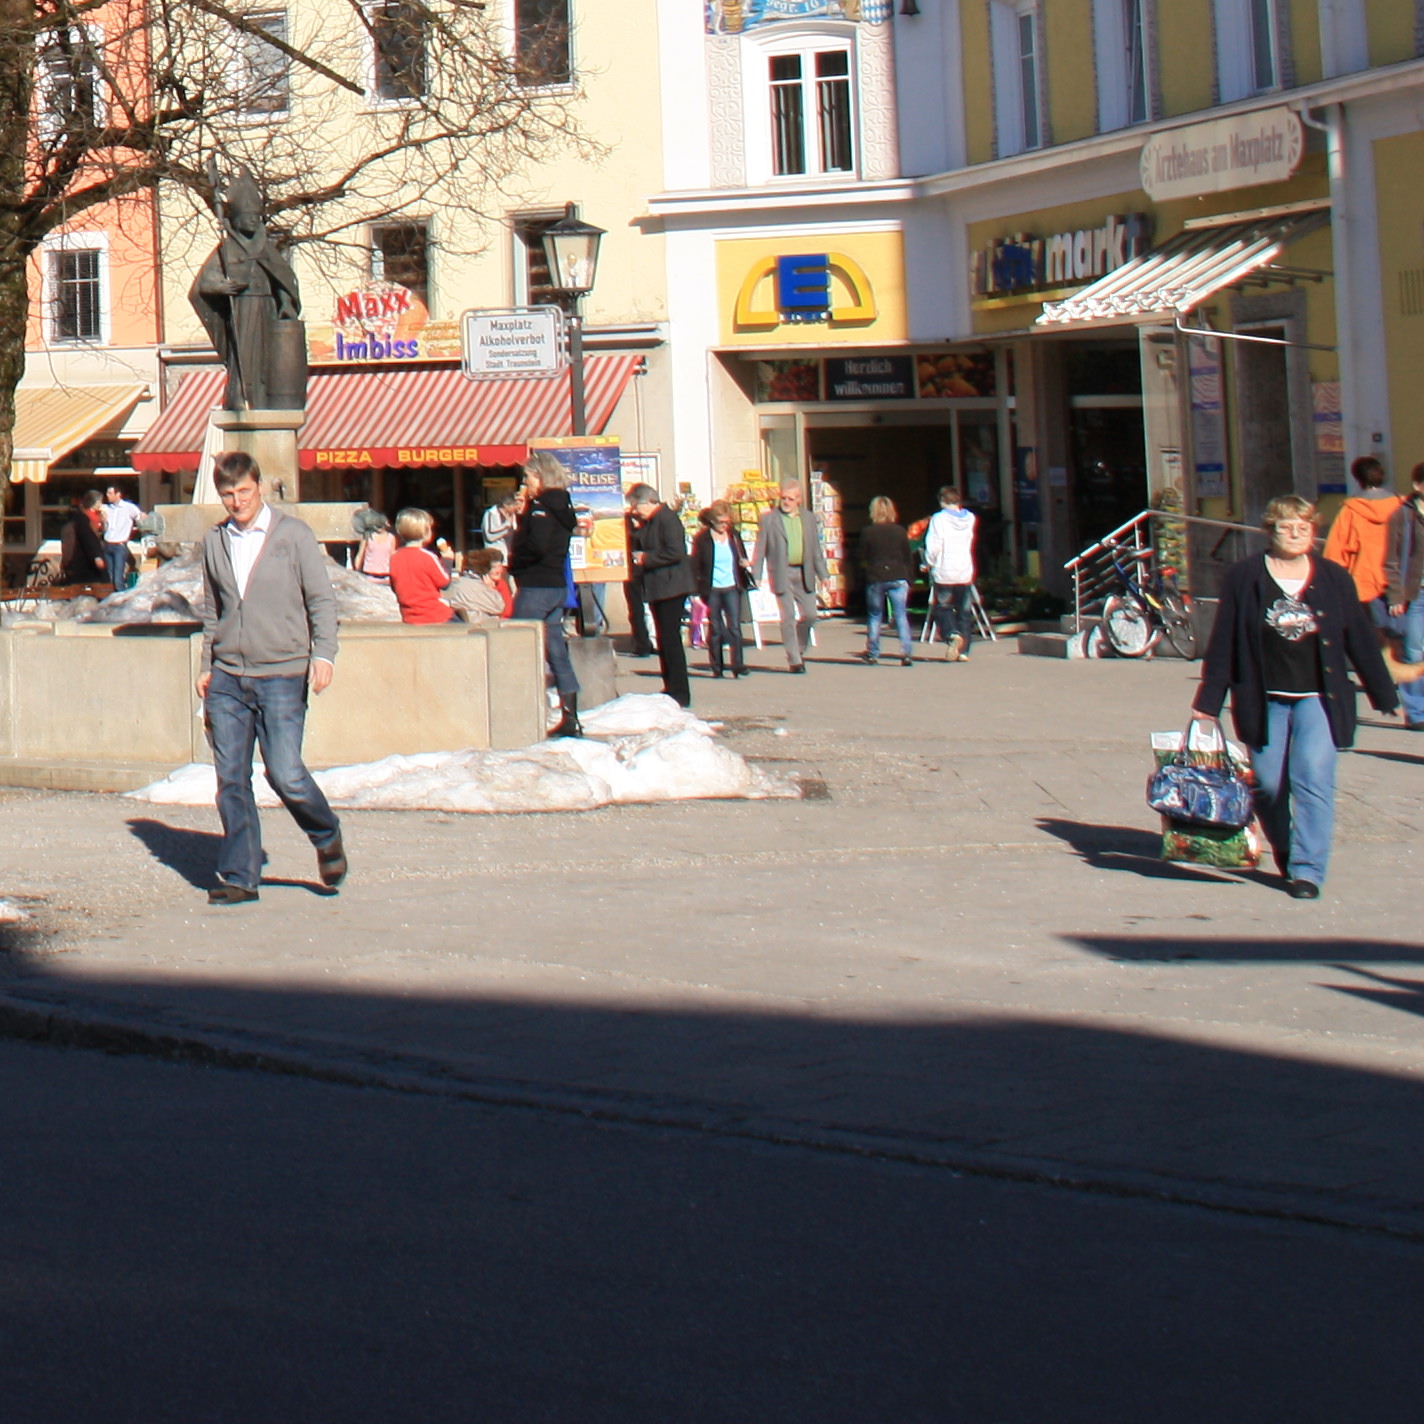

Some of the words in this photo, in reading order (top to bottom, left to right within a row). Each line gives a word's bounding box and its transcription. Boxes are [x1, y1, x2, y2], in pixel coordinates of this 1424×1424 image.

[1211, 143, 1228, 173] am
[1230, 125, 1283, 173] Maxplatz
[335, 289, 412, 325] Maxx
[490, 319, 532, 333] Maxplatz
[335, 332, 419, 361] Imbiss
[479, 334, 546, 347] Alkoholverbot
[485, 360, 503, 369] Stadt
[316, 451, 373, 464] PIZZA
[397, 448, 479, 463] BURGER
[579, 470, 617, 486] REISE
